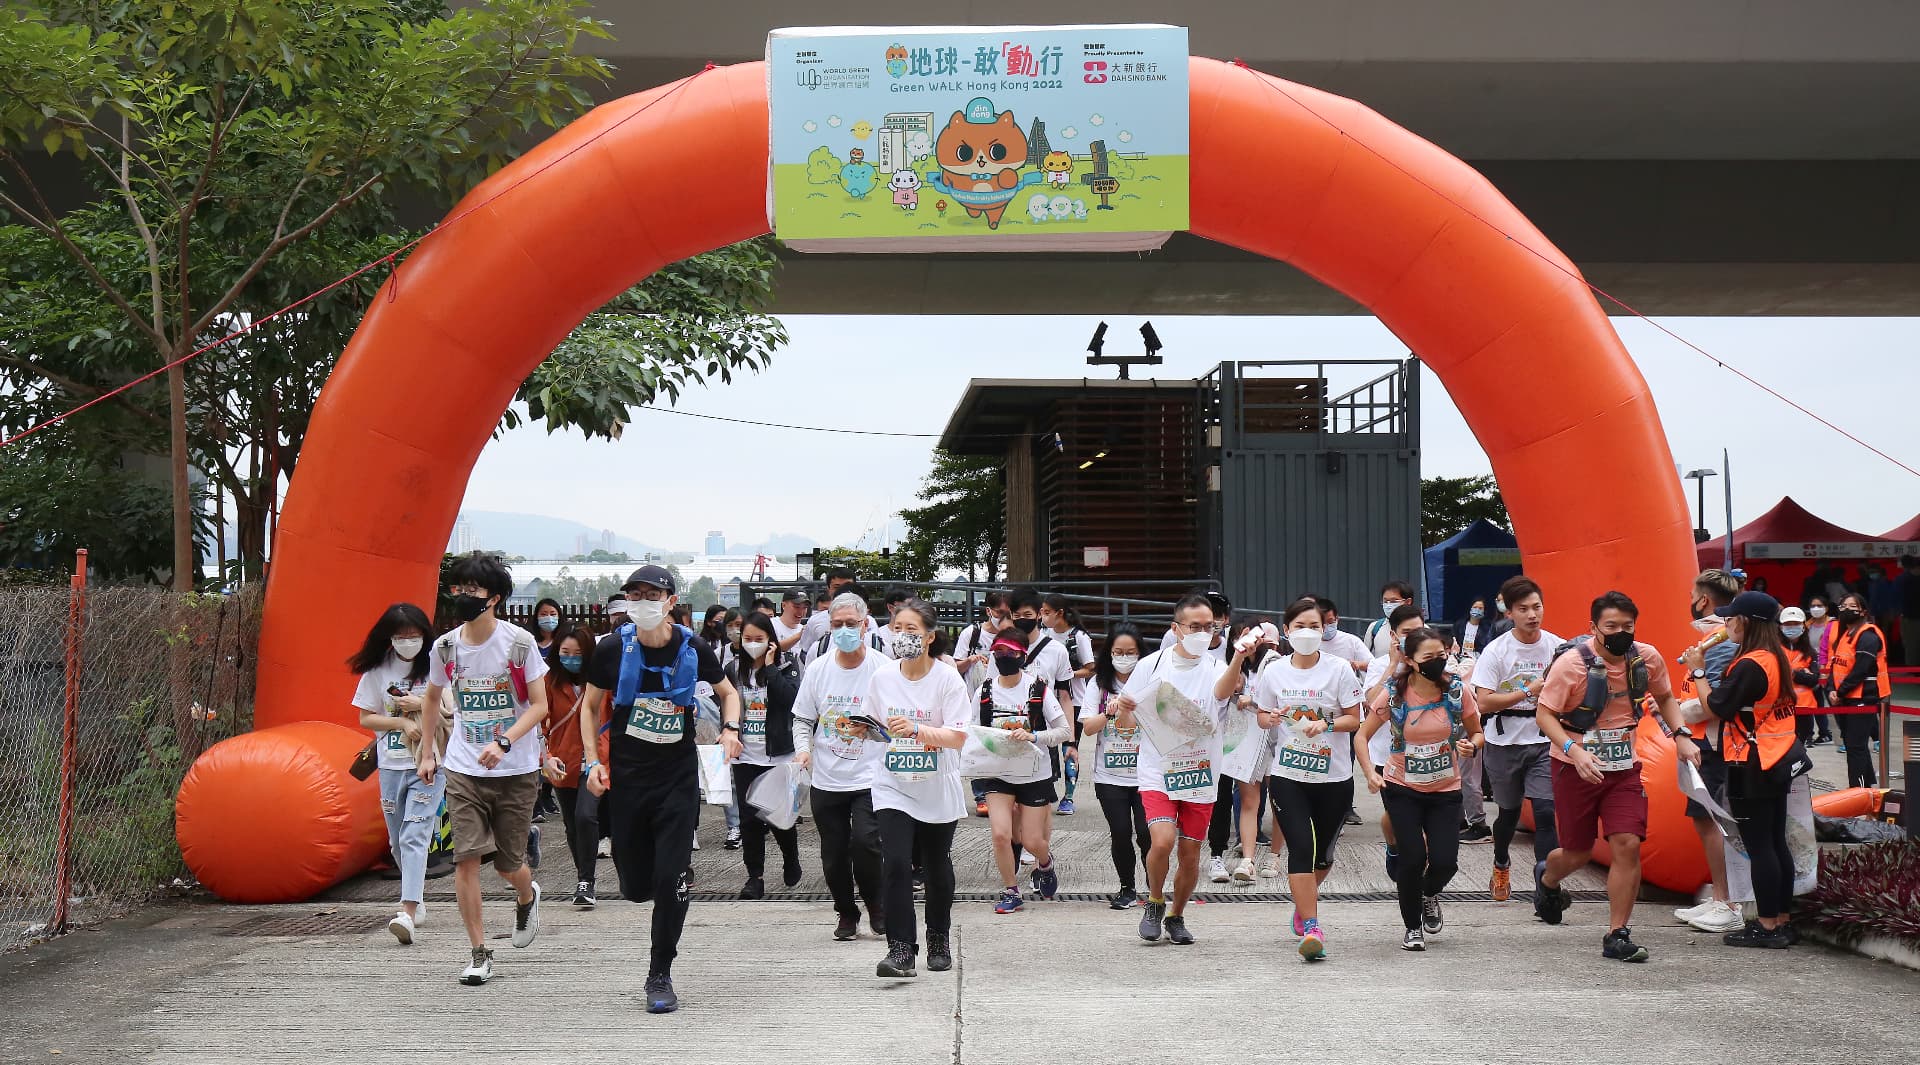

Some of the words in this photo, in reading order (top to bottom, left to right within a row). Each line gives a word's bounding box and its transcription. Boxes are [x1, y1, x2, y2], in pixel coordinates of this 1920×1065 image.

[1111, 62, 1158, 73] 大新銀行
[890, 83, 925, 93] Green
[928, 81, 963, 92] WALK
[967, 81, 996, 93] Hong
[1000, 80, 1029, 92] Kong
[1032, 79, 1063, 90] 2022
[970, 110, 991, 119] dong
[974, 104, 988, 112] din
[463, 693, 508, 708] P216B
[632, 709, 682, 731] P216A
[888, 754, 935, 769] P203A
[1282, 750, 1327, 770] P207B
[1407, 755, 1450, 771] P213B
[1167, 771, 1210, 789] P207A
